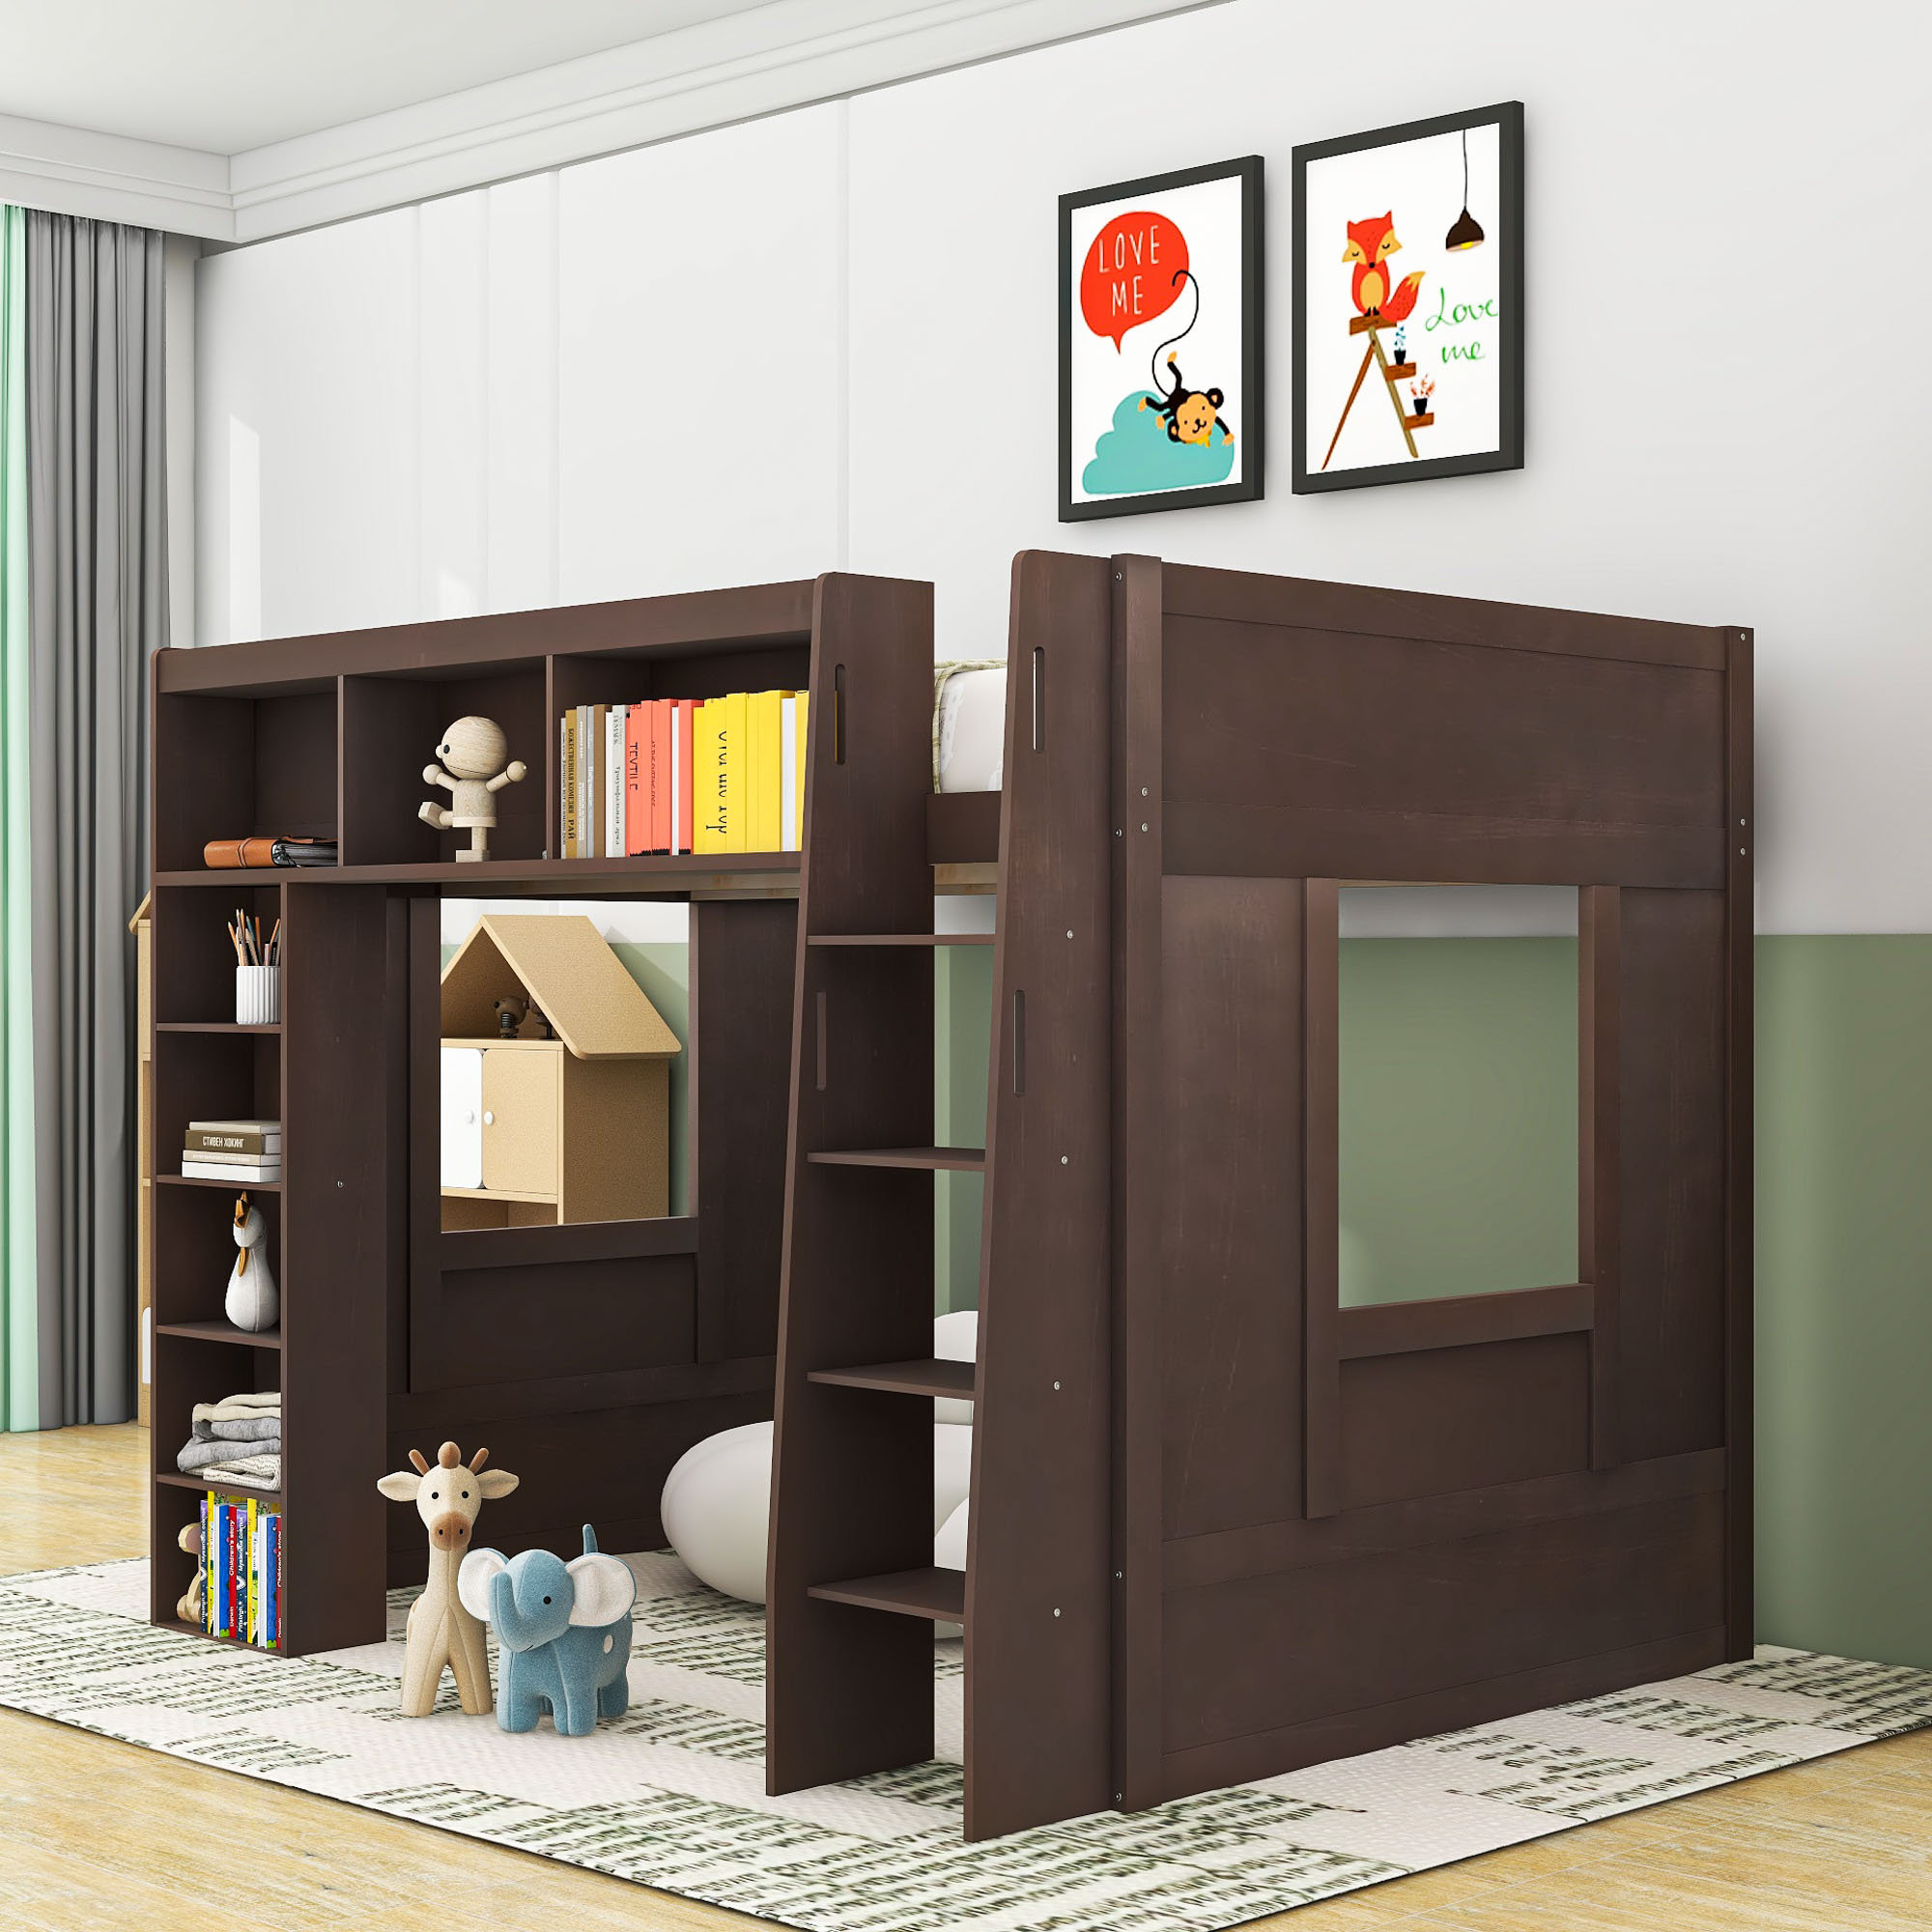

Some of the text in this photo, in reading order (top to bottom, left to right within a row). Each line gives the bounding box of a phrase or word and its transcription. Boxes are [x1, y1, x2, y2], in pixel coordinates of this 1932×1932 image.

[1098, 225, 1160, 273] LOVE
[1112, 275, 1144, 317] ME
[1425, 287, 1498, 331] Love
[1441, 341, 1486, 364] me
[567, 819, 576, 839] РАЙ
